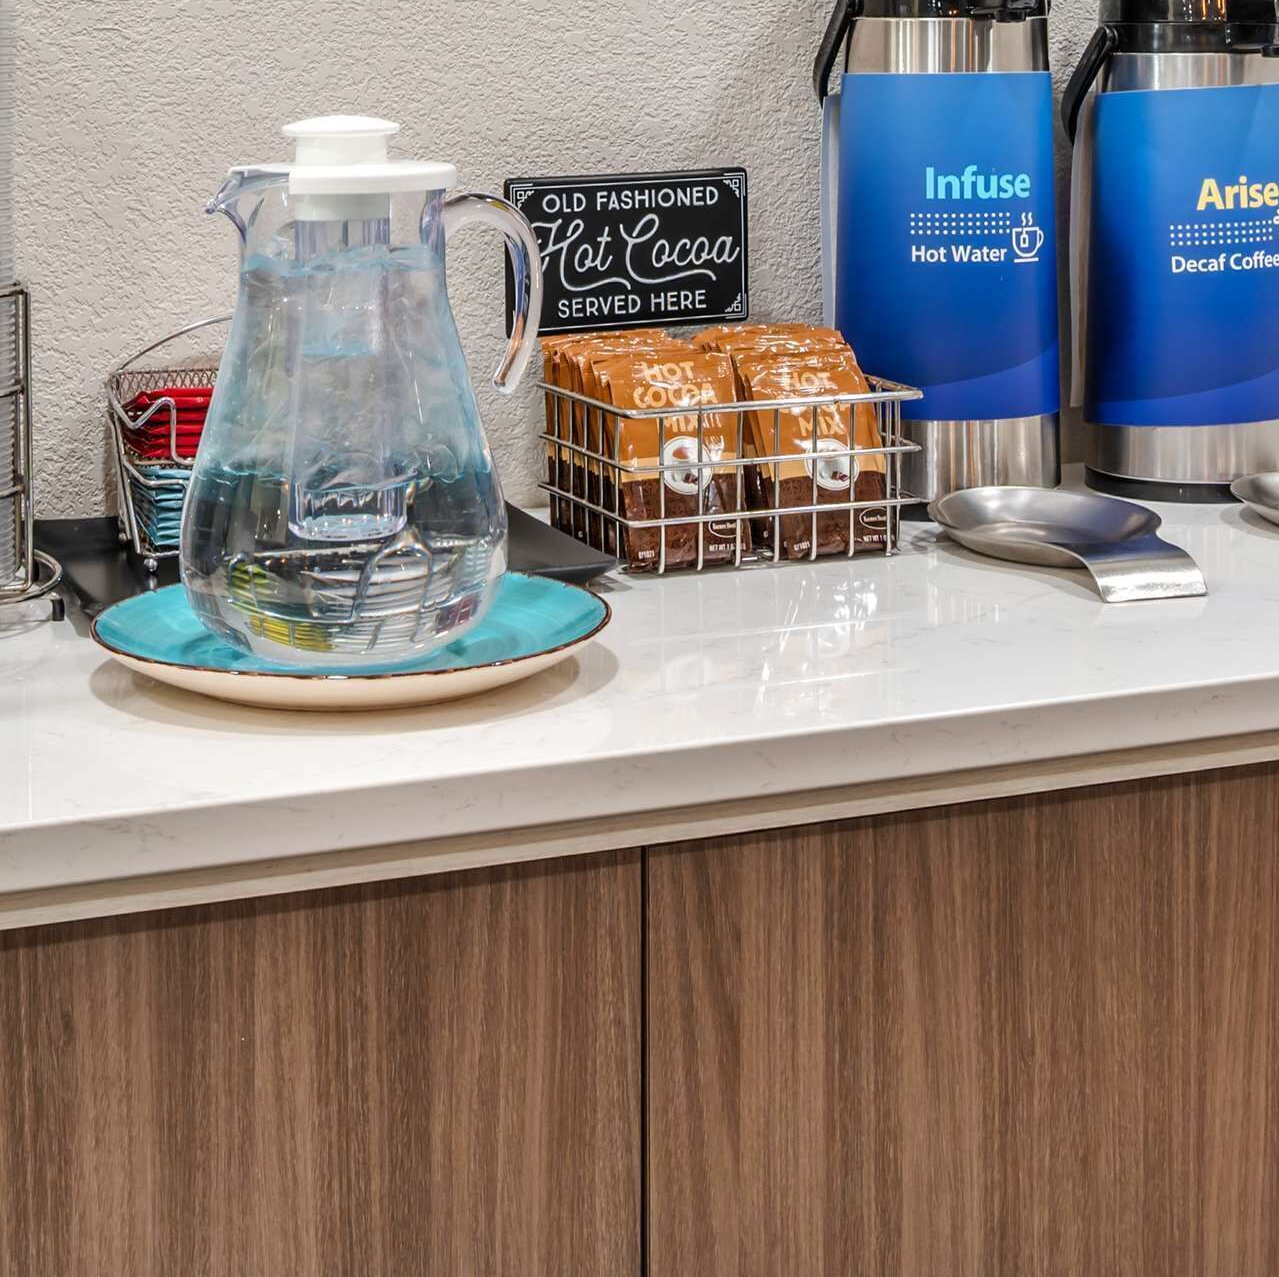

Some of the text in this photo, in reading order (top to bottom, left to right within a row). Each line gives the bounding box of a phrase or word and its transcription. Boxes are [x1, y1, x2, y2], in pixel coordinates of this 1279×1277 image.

[926, 165, 1031, 199] Infuse
[1196, 175, 1279, 211] Arise
[542, 186, 719, 213] OLD FASHIONED
[531, 214, 740, 291] Hot Cocoa
[911, 245, 1007, 263] Hot Water
[1171, 253, 1226, 273] Decaf
[558, 290, 707, 318] SERVED HERE
[642, 361, 694, 383] HOT
[798, 416, 846, 437] MIX
